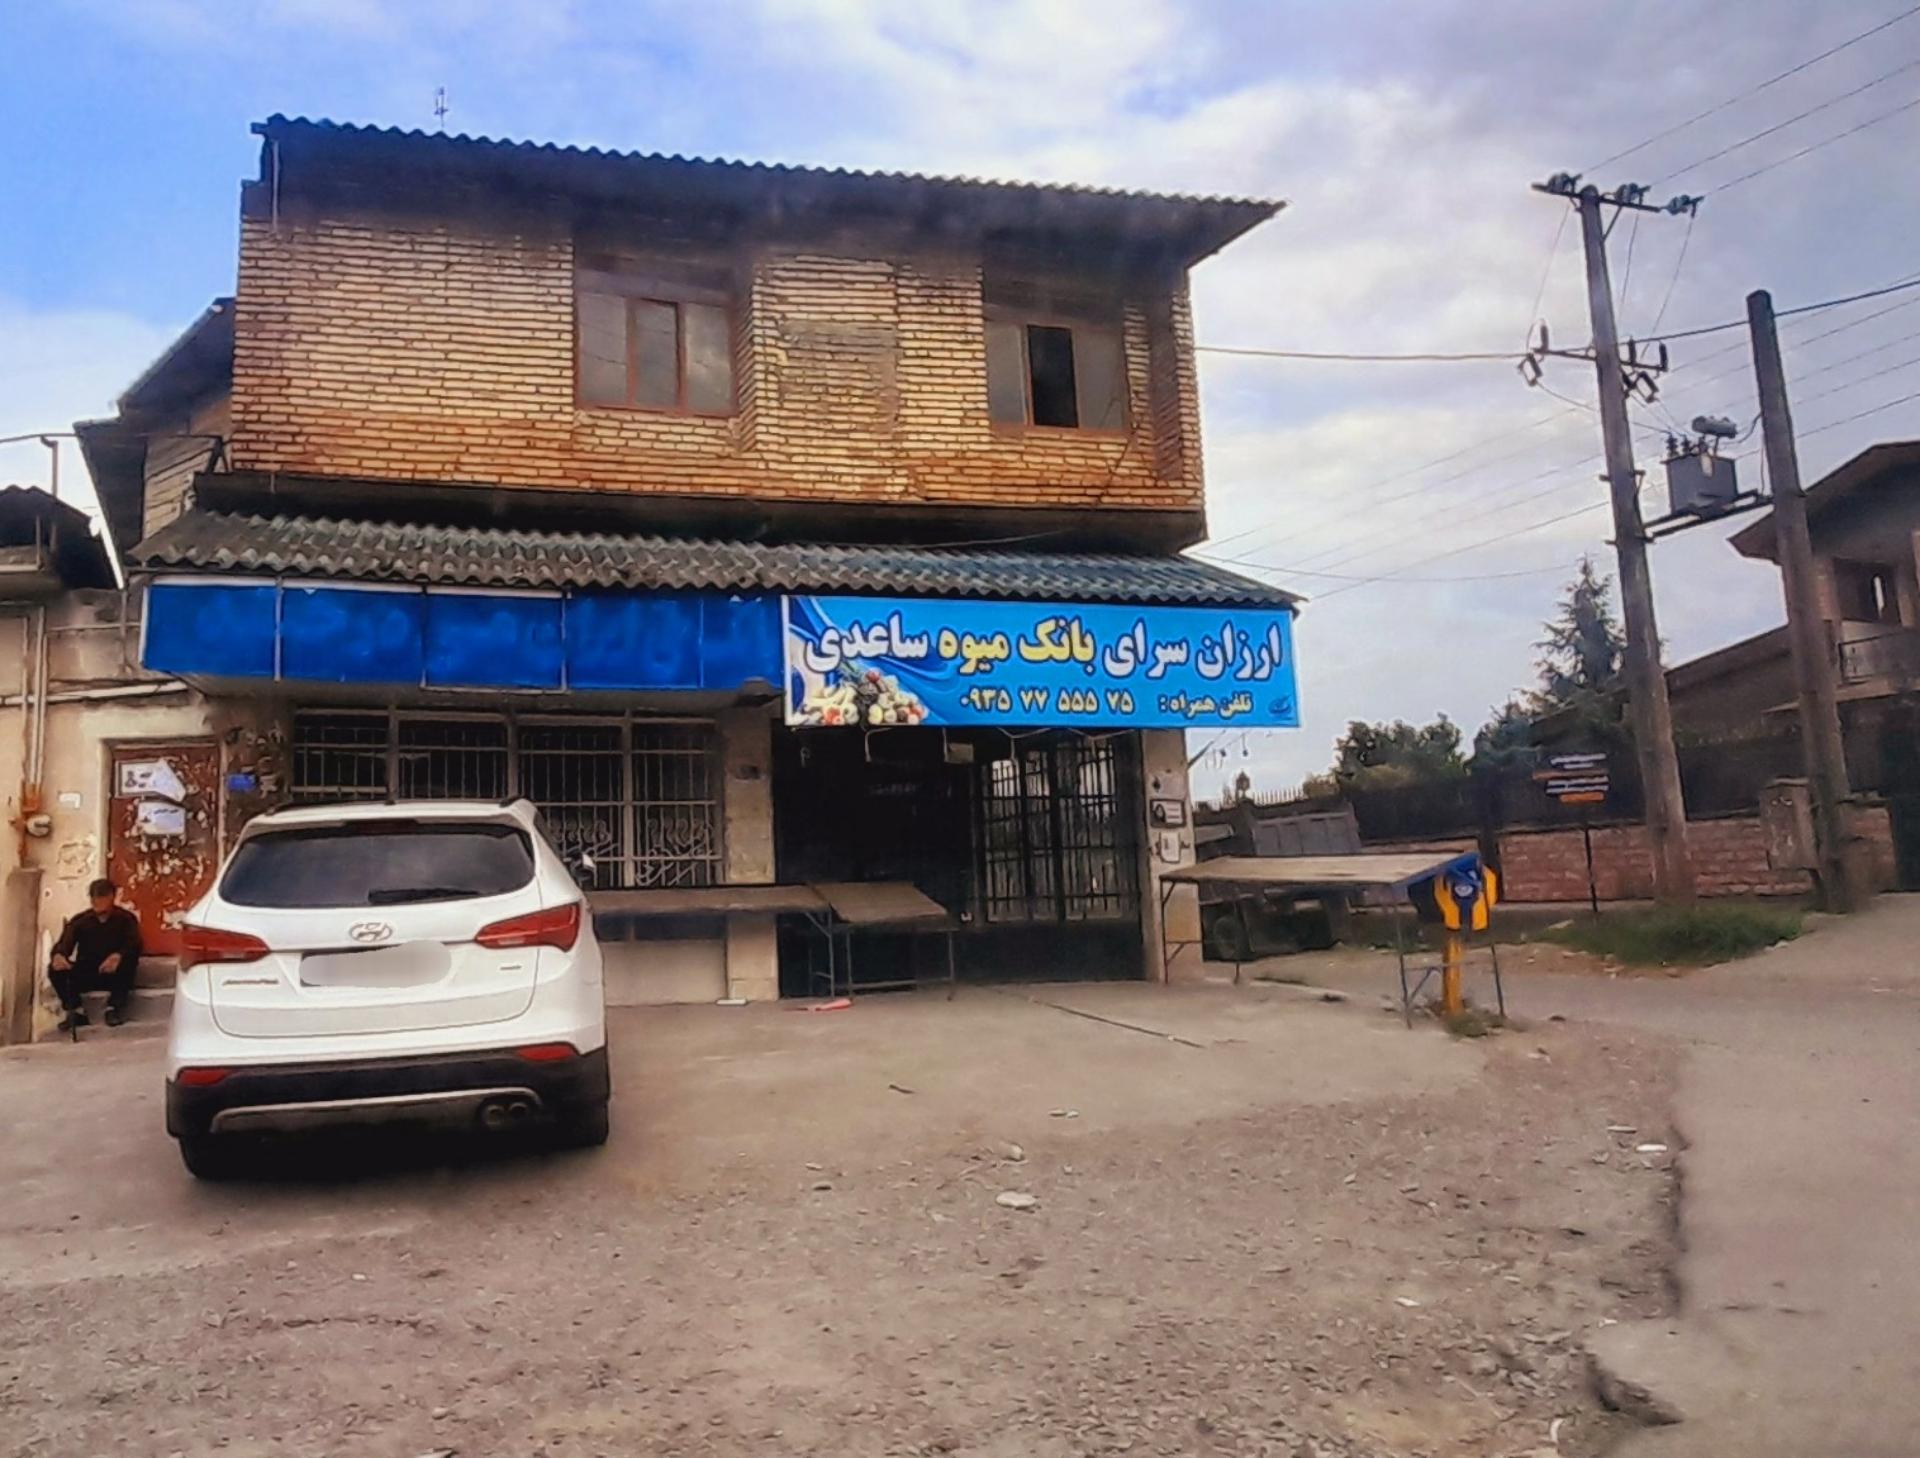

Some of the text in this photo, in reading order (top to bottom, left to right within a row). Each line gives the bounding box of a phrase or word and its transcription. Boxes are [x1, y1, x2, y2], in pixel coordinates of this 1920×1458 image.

[804, 610, 928, 673] ساعدی
[938, 627, 1010, 674] میوه
[1018, 615, 1095, 674] بانک
[1197, 621, 1281, 679] ارزان
[1219, 691, 1253, 718] تلفن
